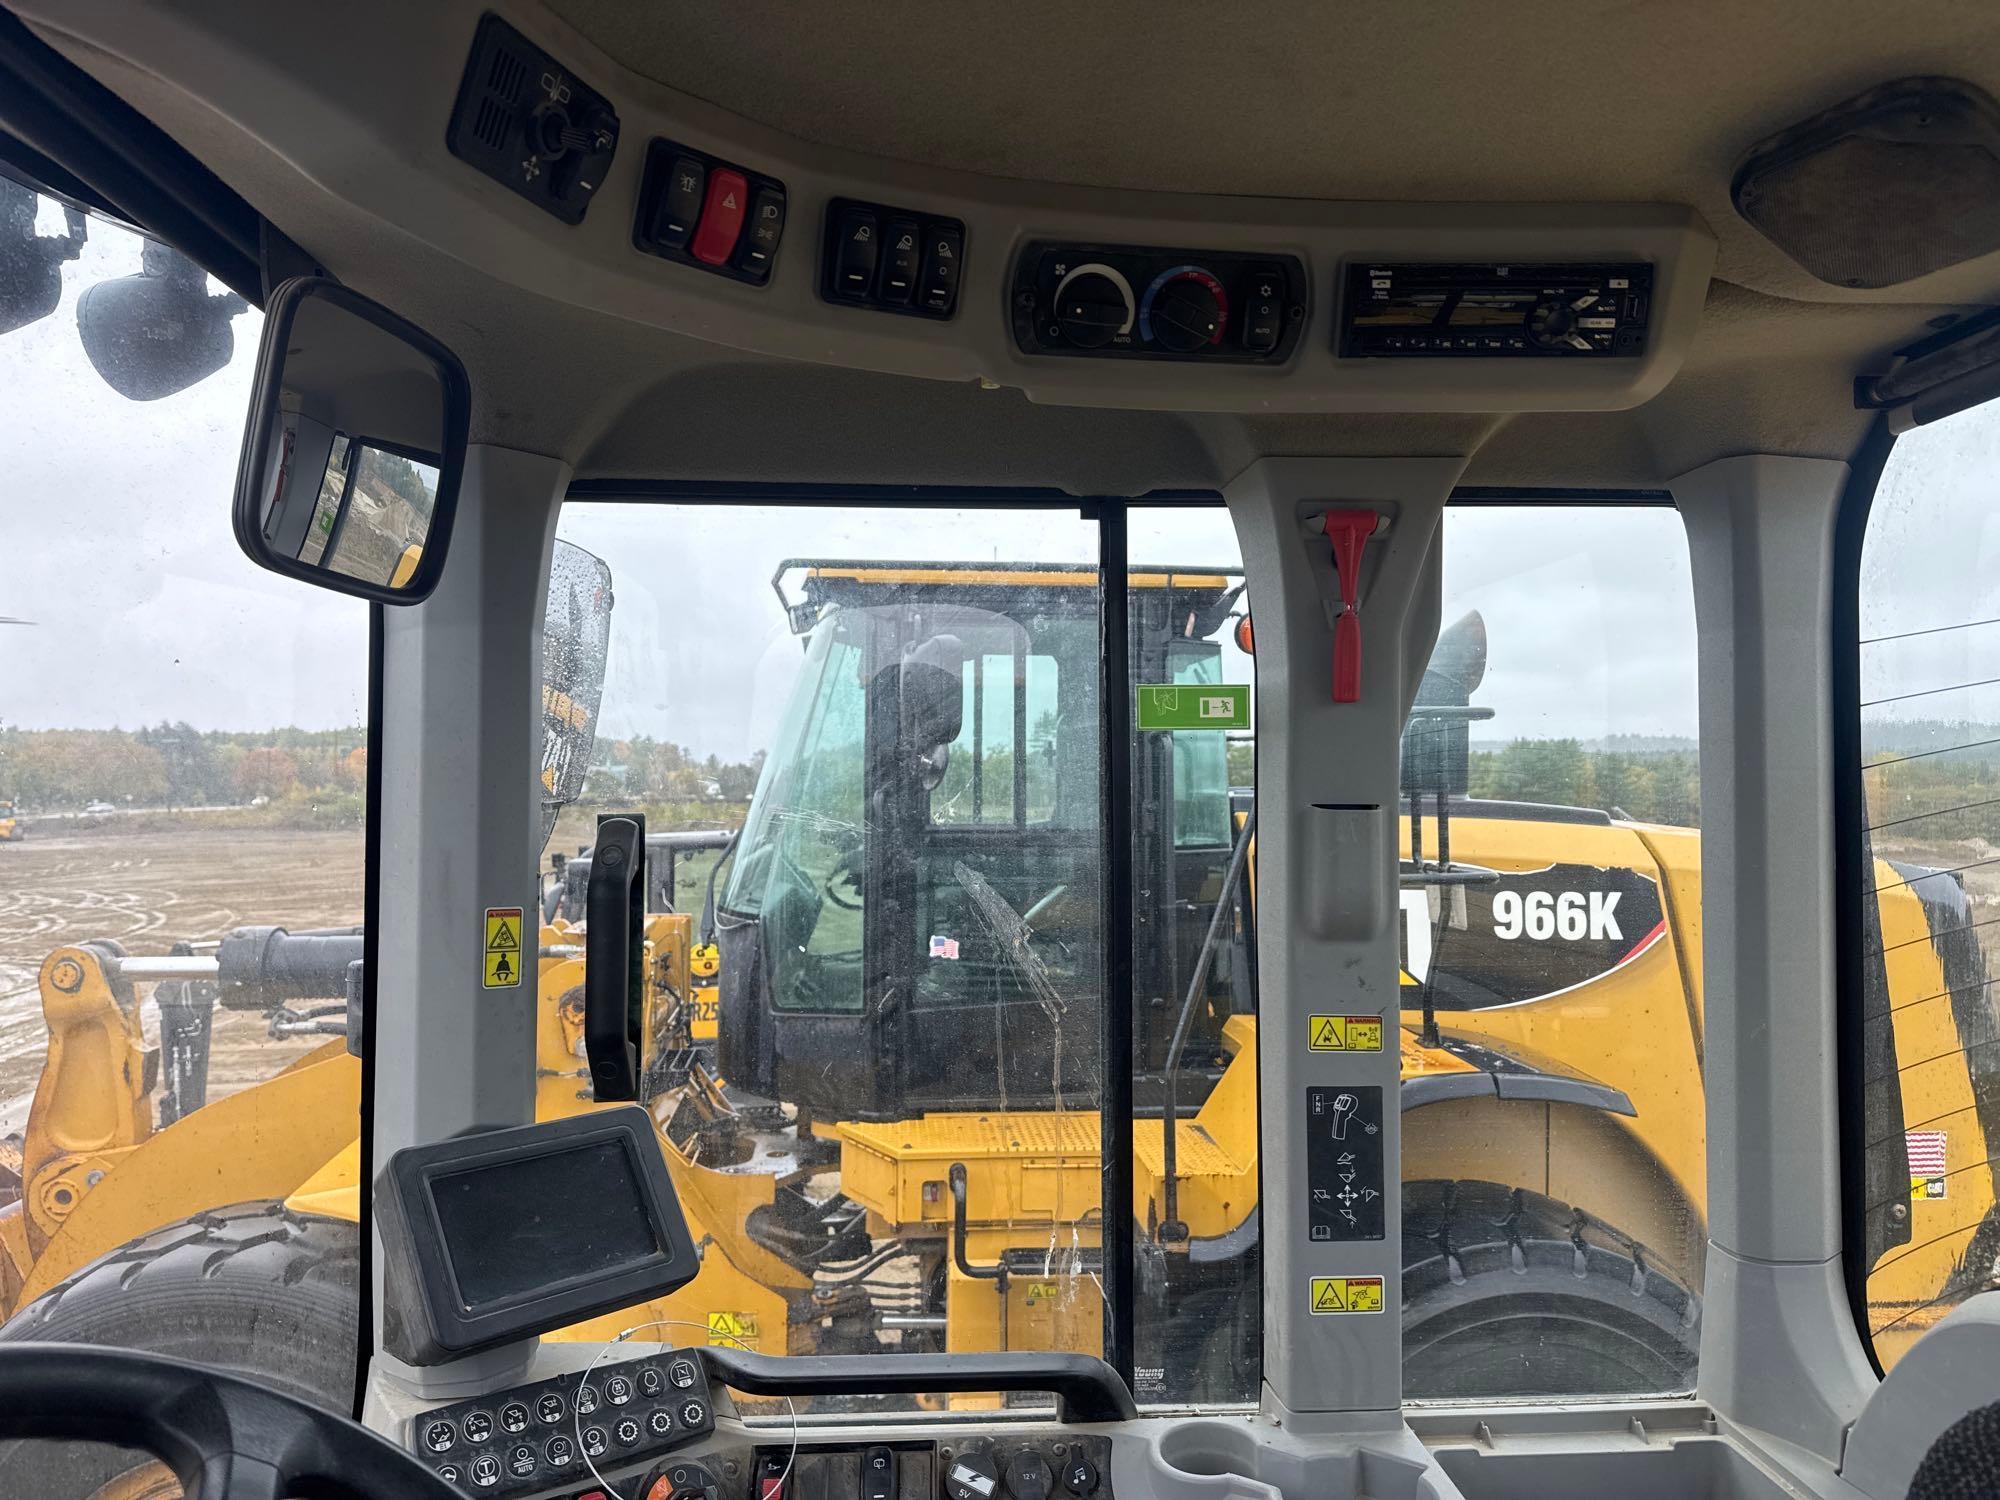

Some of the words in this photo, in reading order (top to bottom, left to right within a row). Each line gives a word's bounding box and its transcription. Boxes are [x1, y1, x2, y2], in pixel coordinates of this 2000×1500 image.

[1113, 336, 1132, 344] AUTO
[1492, 890, 1624, 941] 966K
[1134, 1366, 1165, 1380] Young
[658, 1418, 665, 1426] 3
[625, 1427, 632, 1436] 2
[517, 1464, 534, 1474] AUTO
[958, 1488, 971, 1499] 5V
